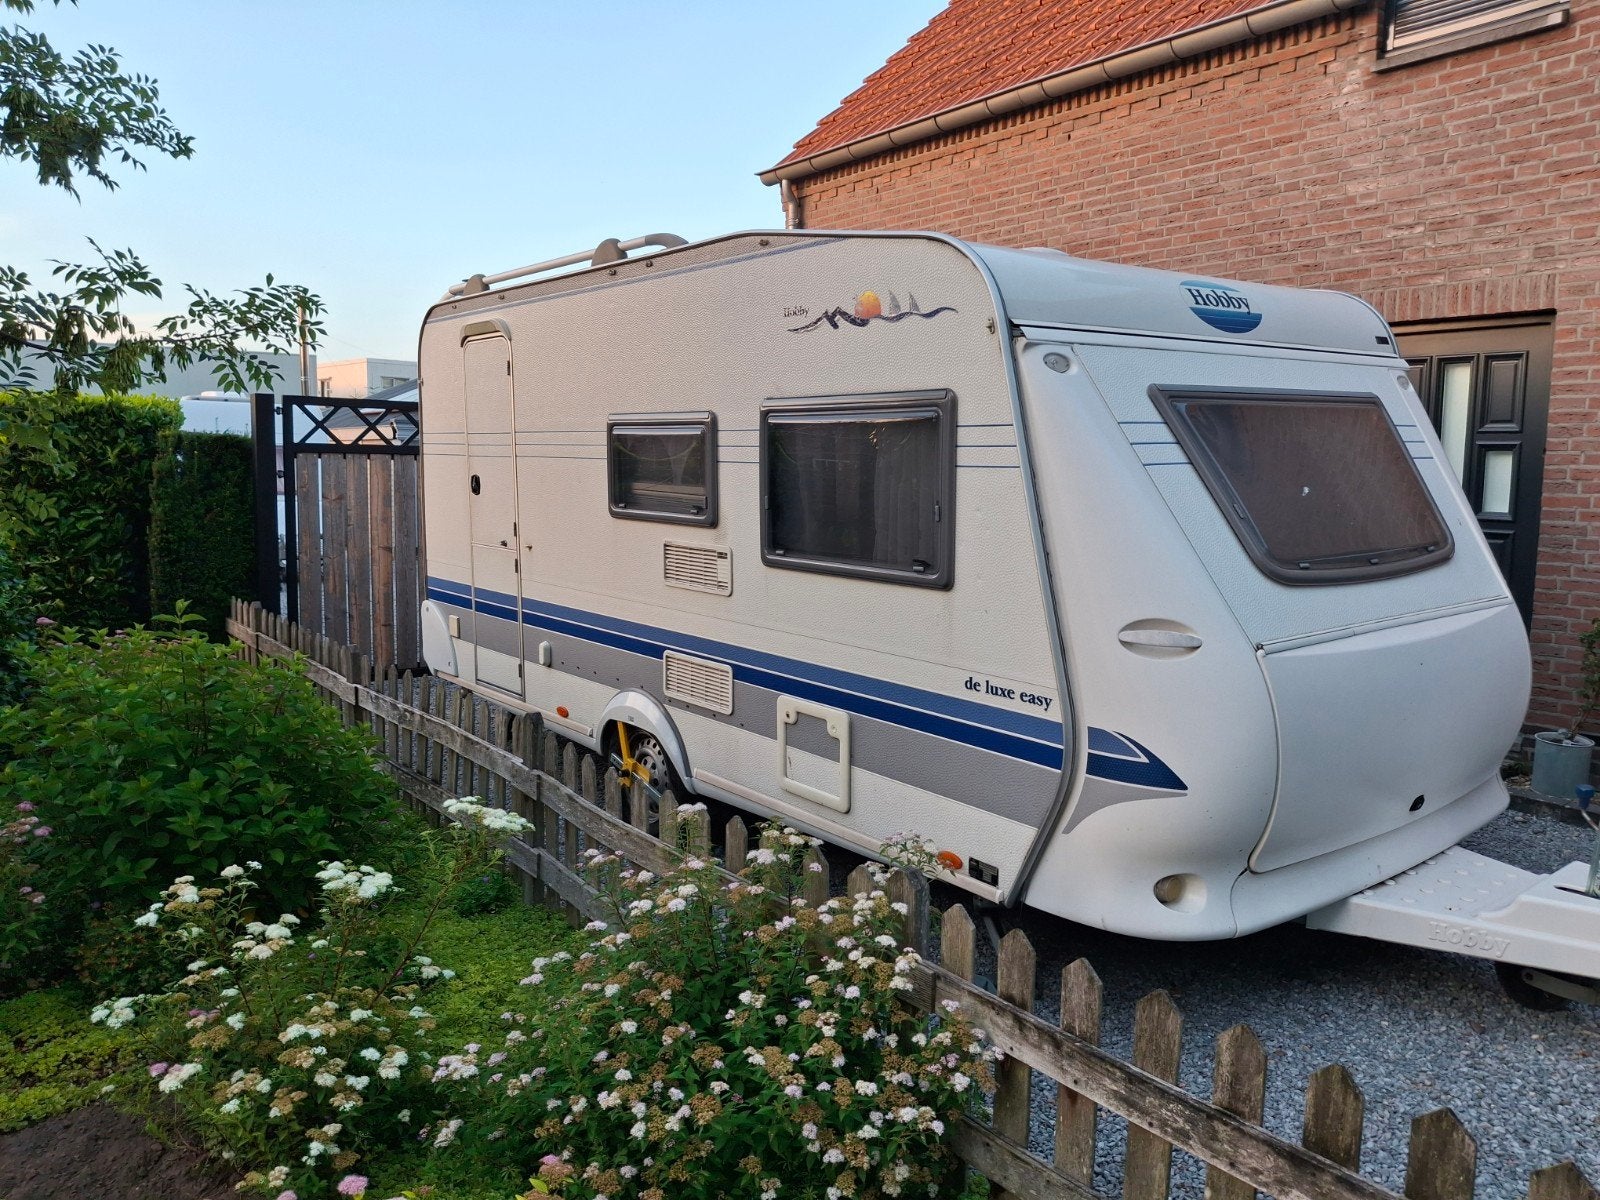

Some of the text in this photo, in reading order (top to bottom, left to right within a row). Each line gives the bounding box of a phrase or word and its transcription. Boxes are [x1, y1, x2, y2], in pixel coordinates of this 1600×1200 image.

[1184, 287, 1251, 316] Hobby
[964, 676, 1053, 711] de luxe easy
